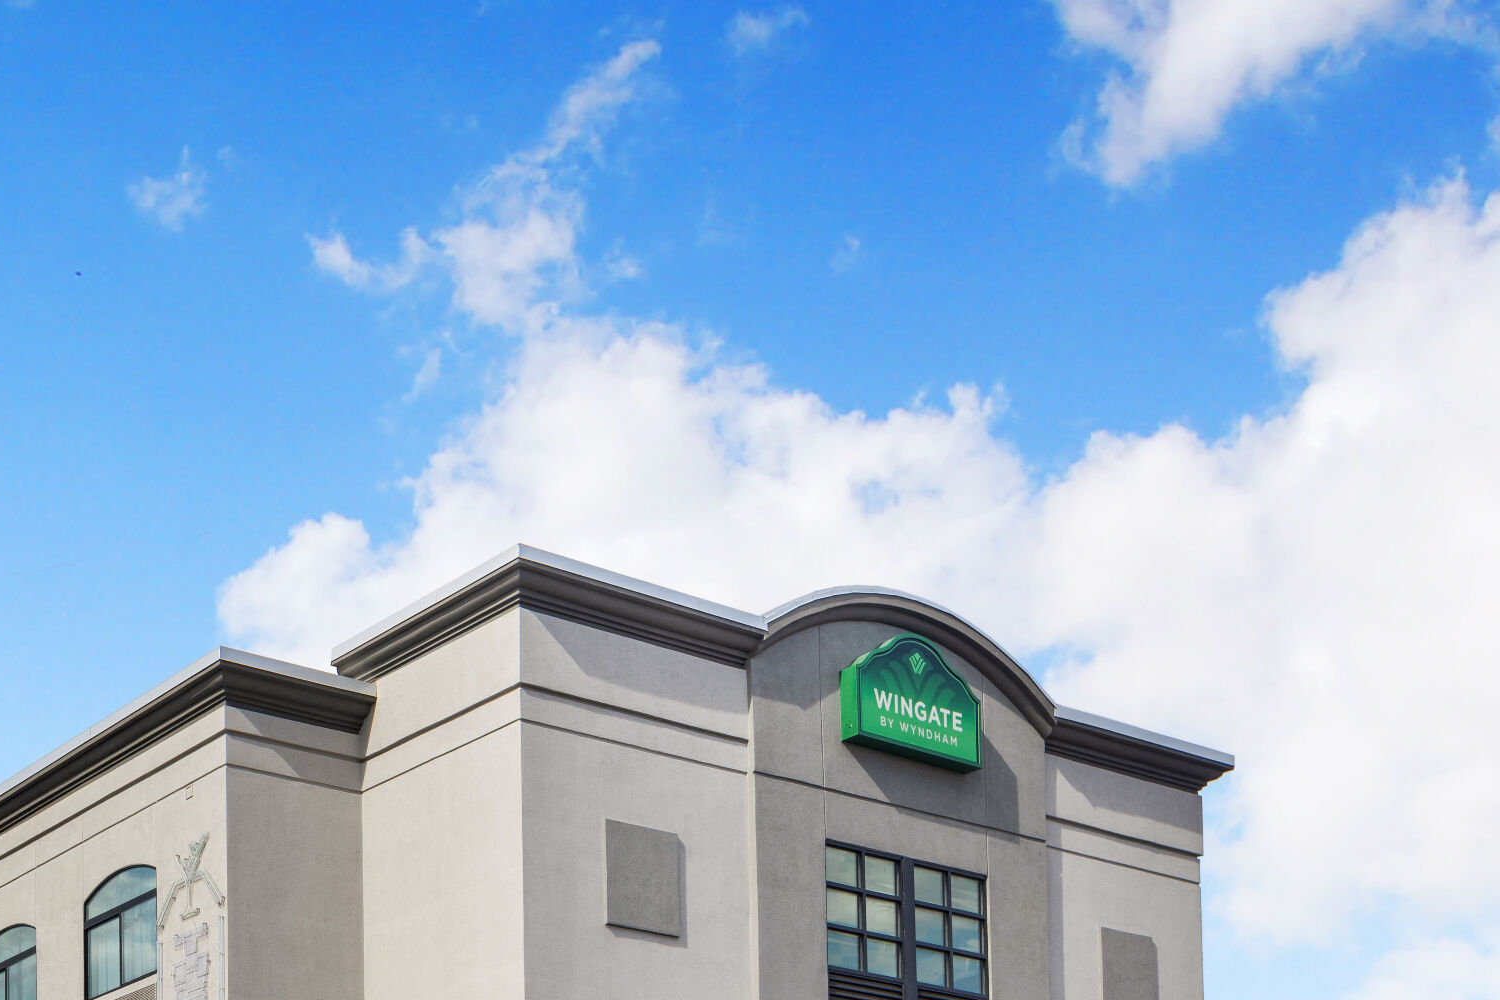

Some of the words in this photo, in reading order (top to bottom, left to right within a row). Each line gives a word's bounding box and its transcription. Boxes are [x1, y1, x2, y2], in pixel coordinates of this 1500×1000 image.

[873, 687, 963, 732] WINGATE
[880, 715, 894, 729] BY
[900, 721, 958, 748] WYNDHAM
